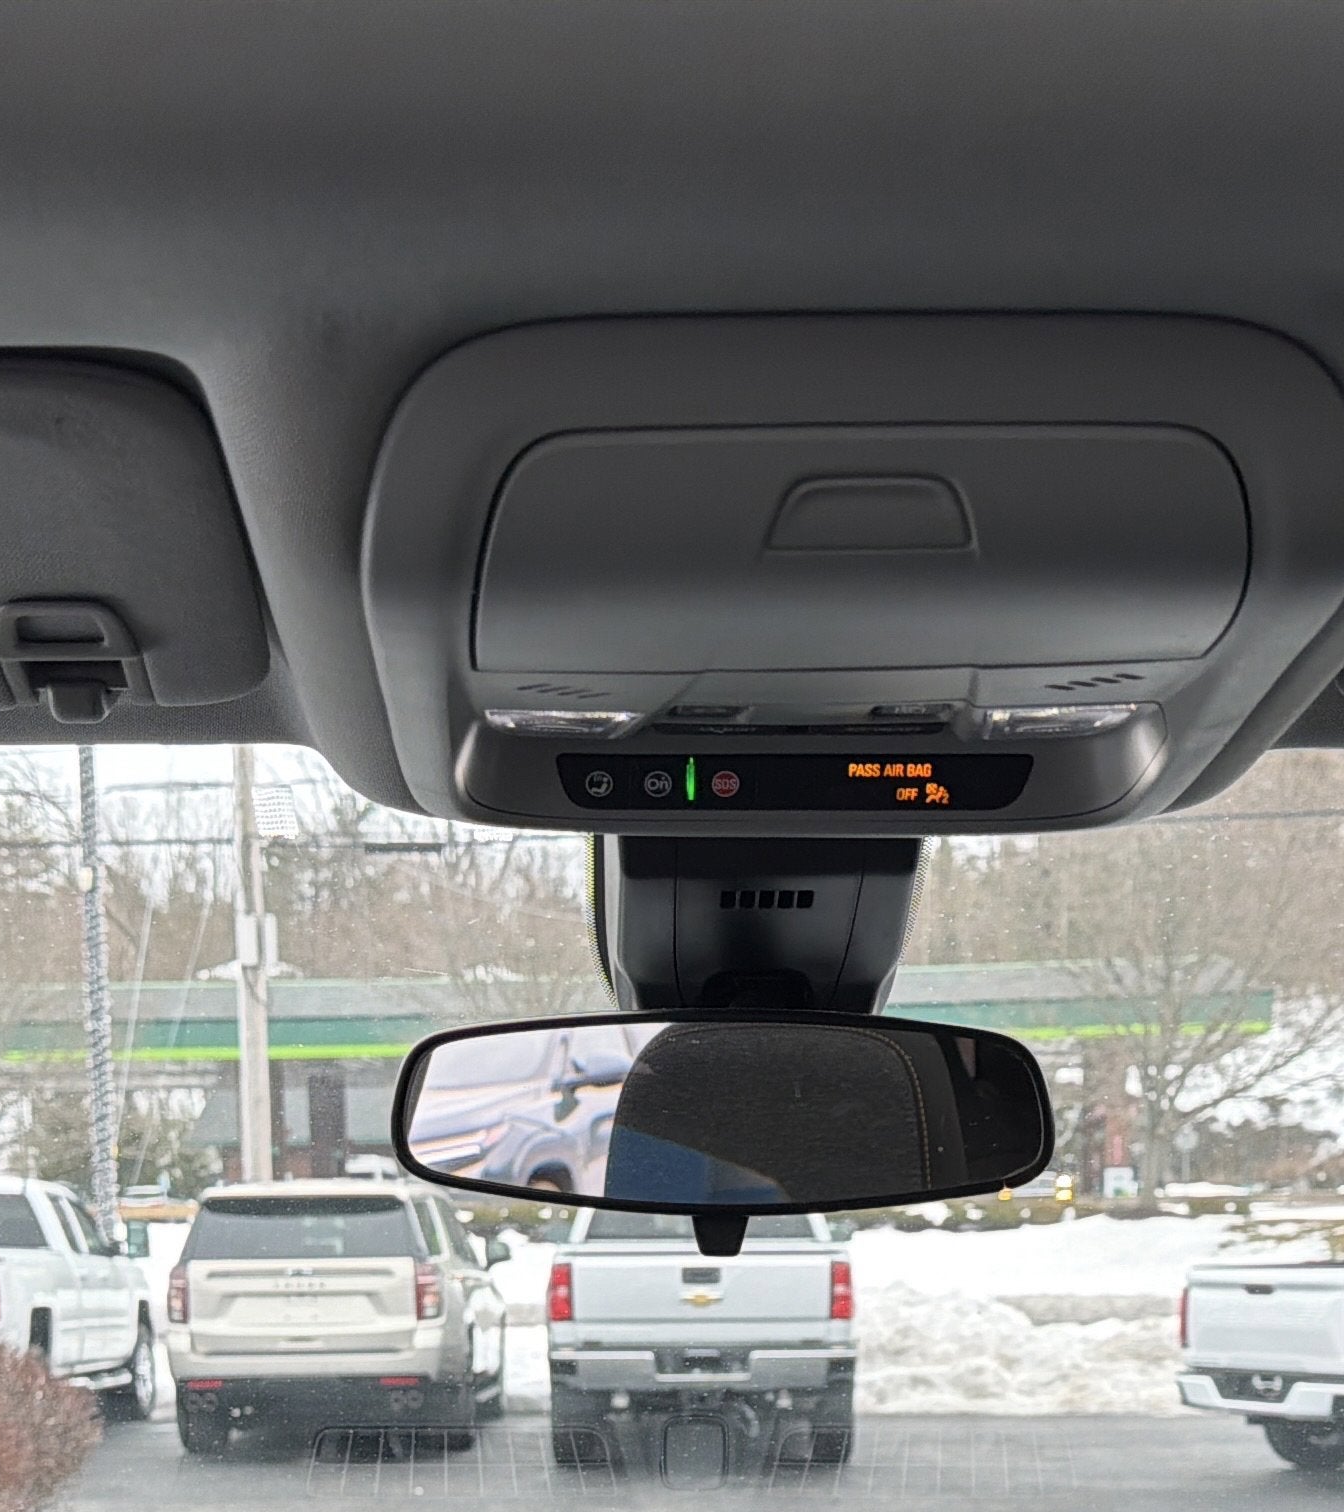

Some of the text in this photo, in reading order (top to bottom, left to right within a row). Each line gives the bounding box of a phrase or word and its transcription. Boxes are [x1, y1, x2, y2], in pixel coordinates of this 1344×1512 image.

[847, 763, 932, 778] PASS AIR BAG
[714, 778, 738, 790] SOS
[896, 787, 919, 801] OFF
